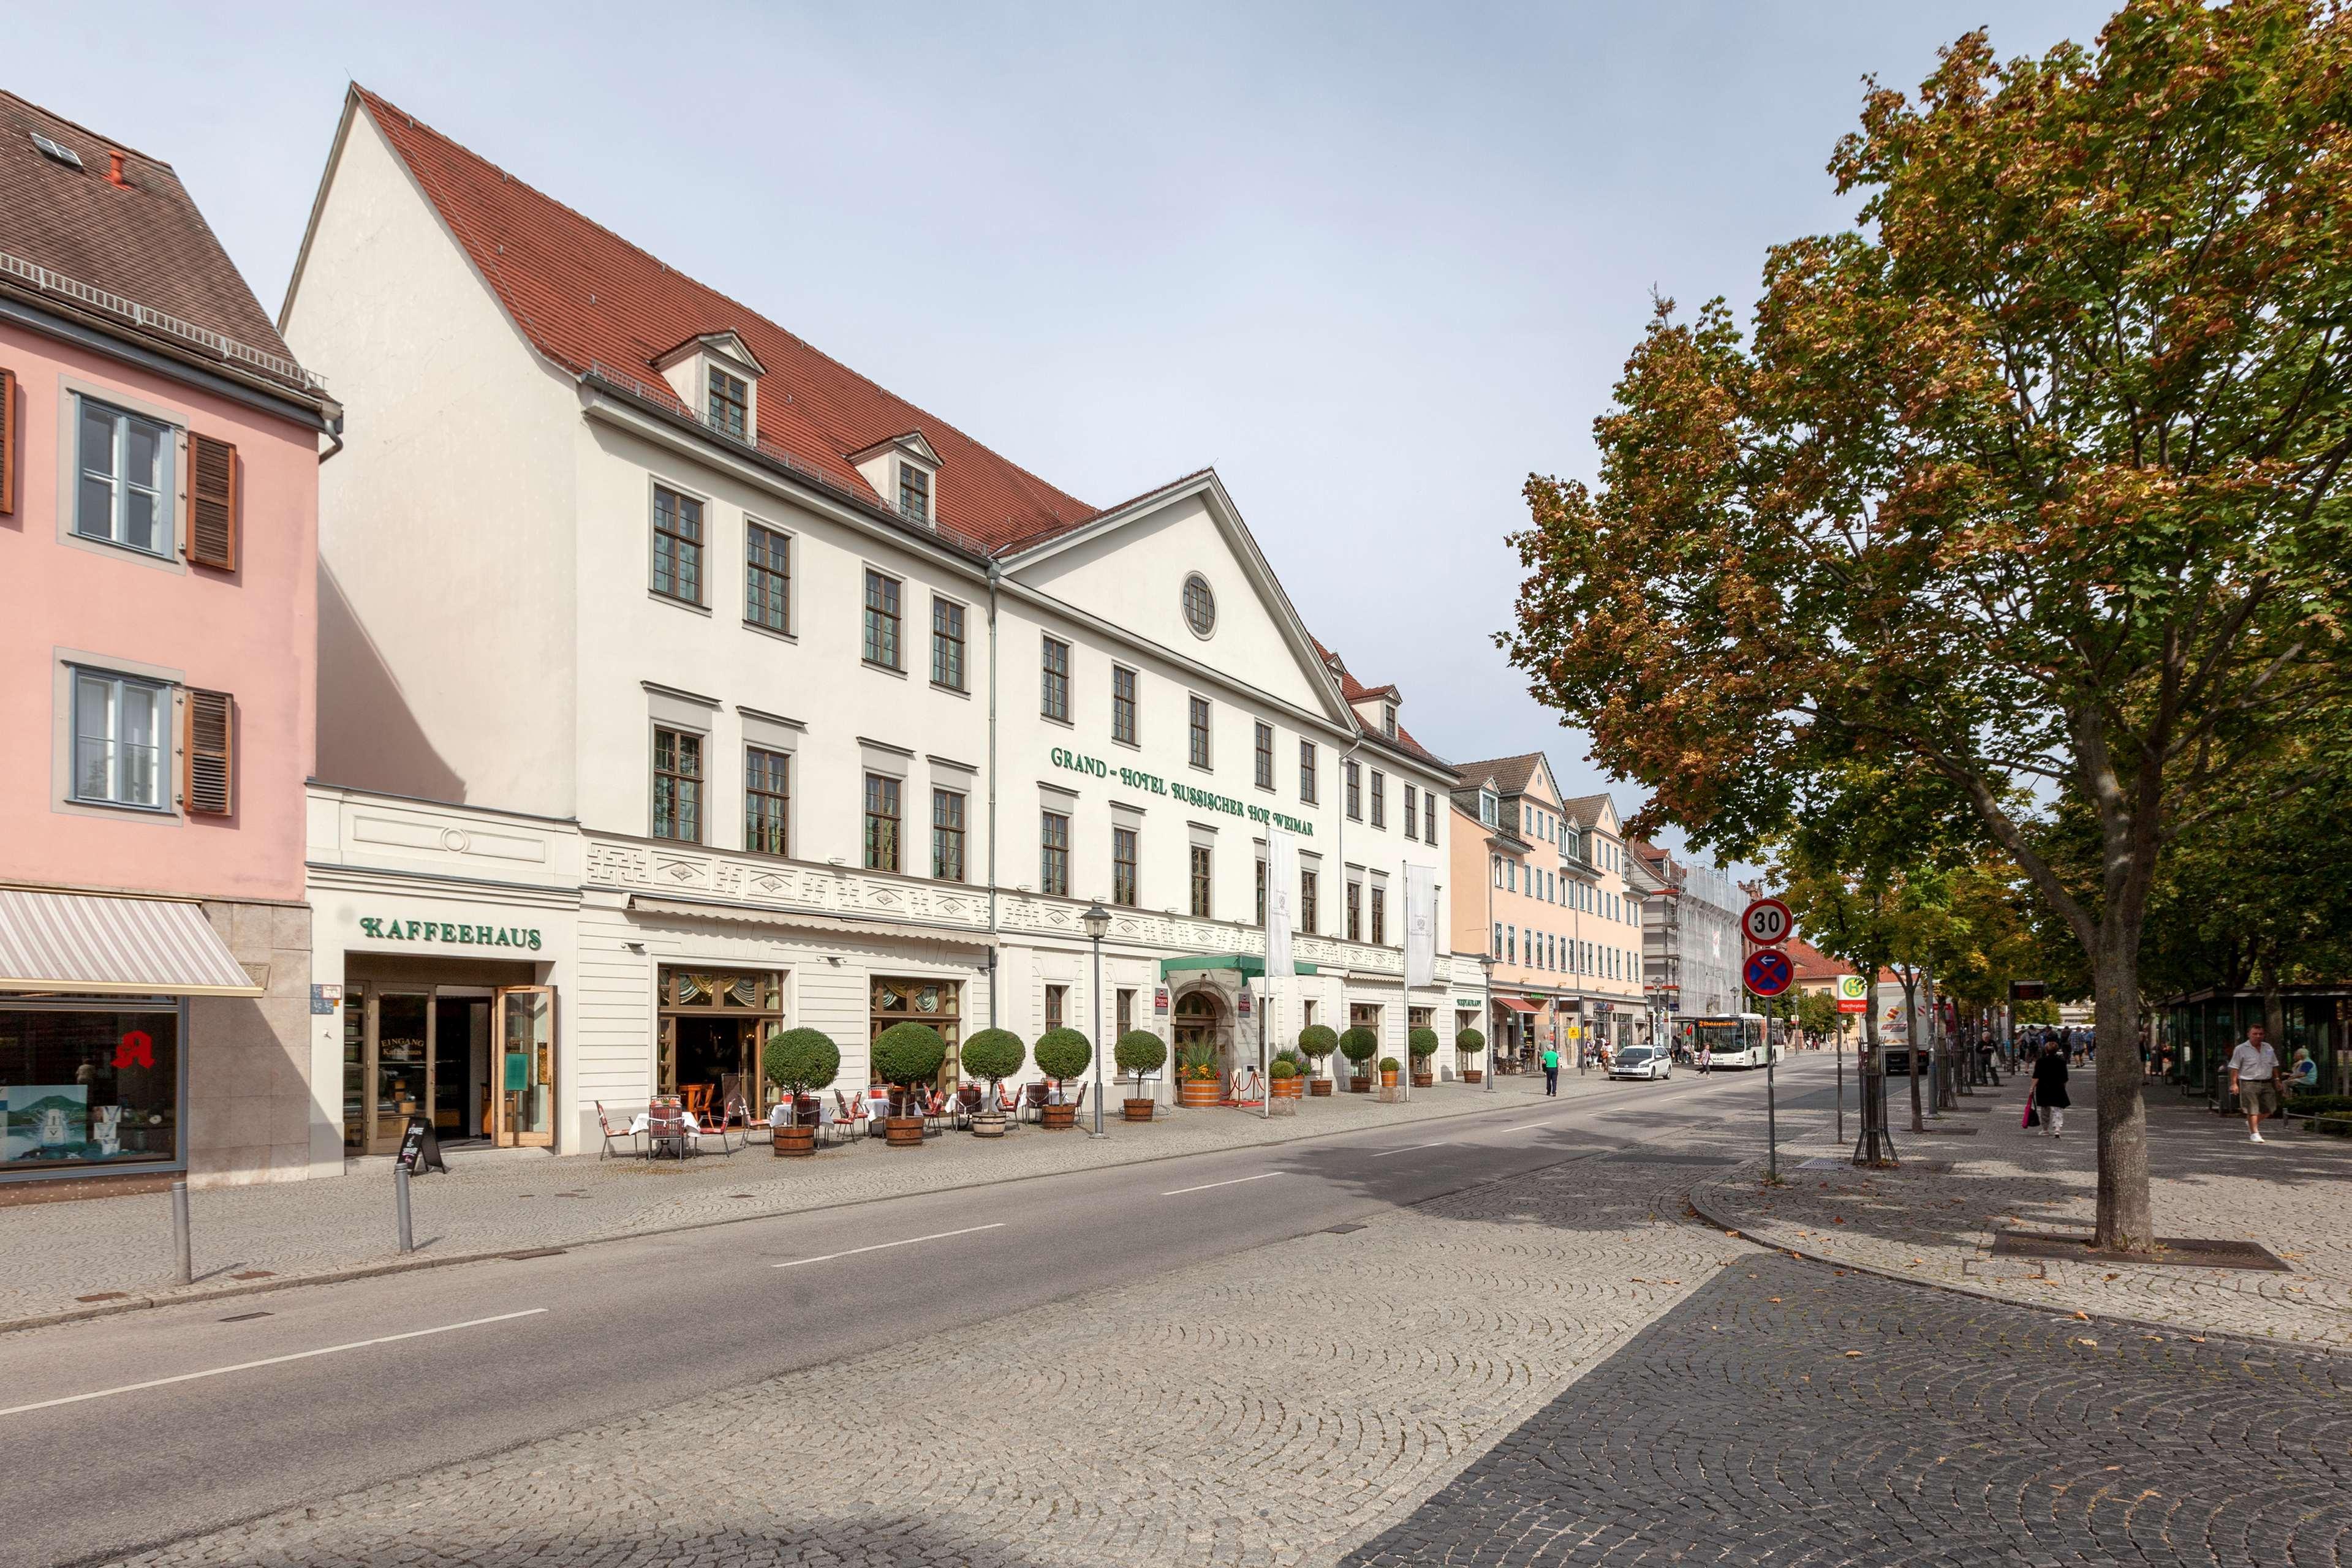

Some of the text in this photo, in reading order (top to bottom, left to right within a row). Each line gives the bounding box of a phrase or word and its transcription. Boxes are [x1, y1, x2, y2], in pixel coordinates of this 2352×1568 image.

[1051, 747, 1107, 779] GRAND
[1120, 767, 1168, 796] HOTEL
[1171, 782, 1245, 818] RUSSISCHER
[1247, 804, 1271, 824] HOF
[1272, 812, 1314, 837] WEIMAR
[360, 917, 542, 951] KAFFEEHAUS
[1754, 911, 1780, 933] 30
[381, 1038, 425, 1047] EINGANG
